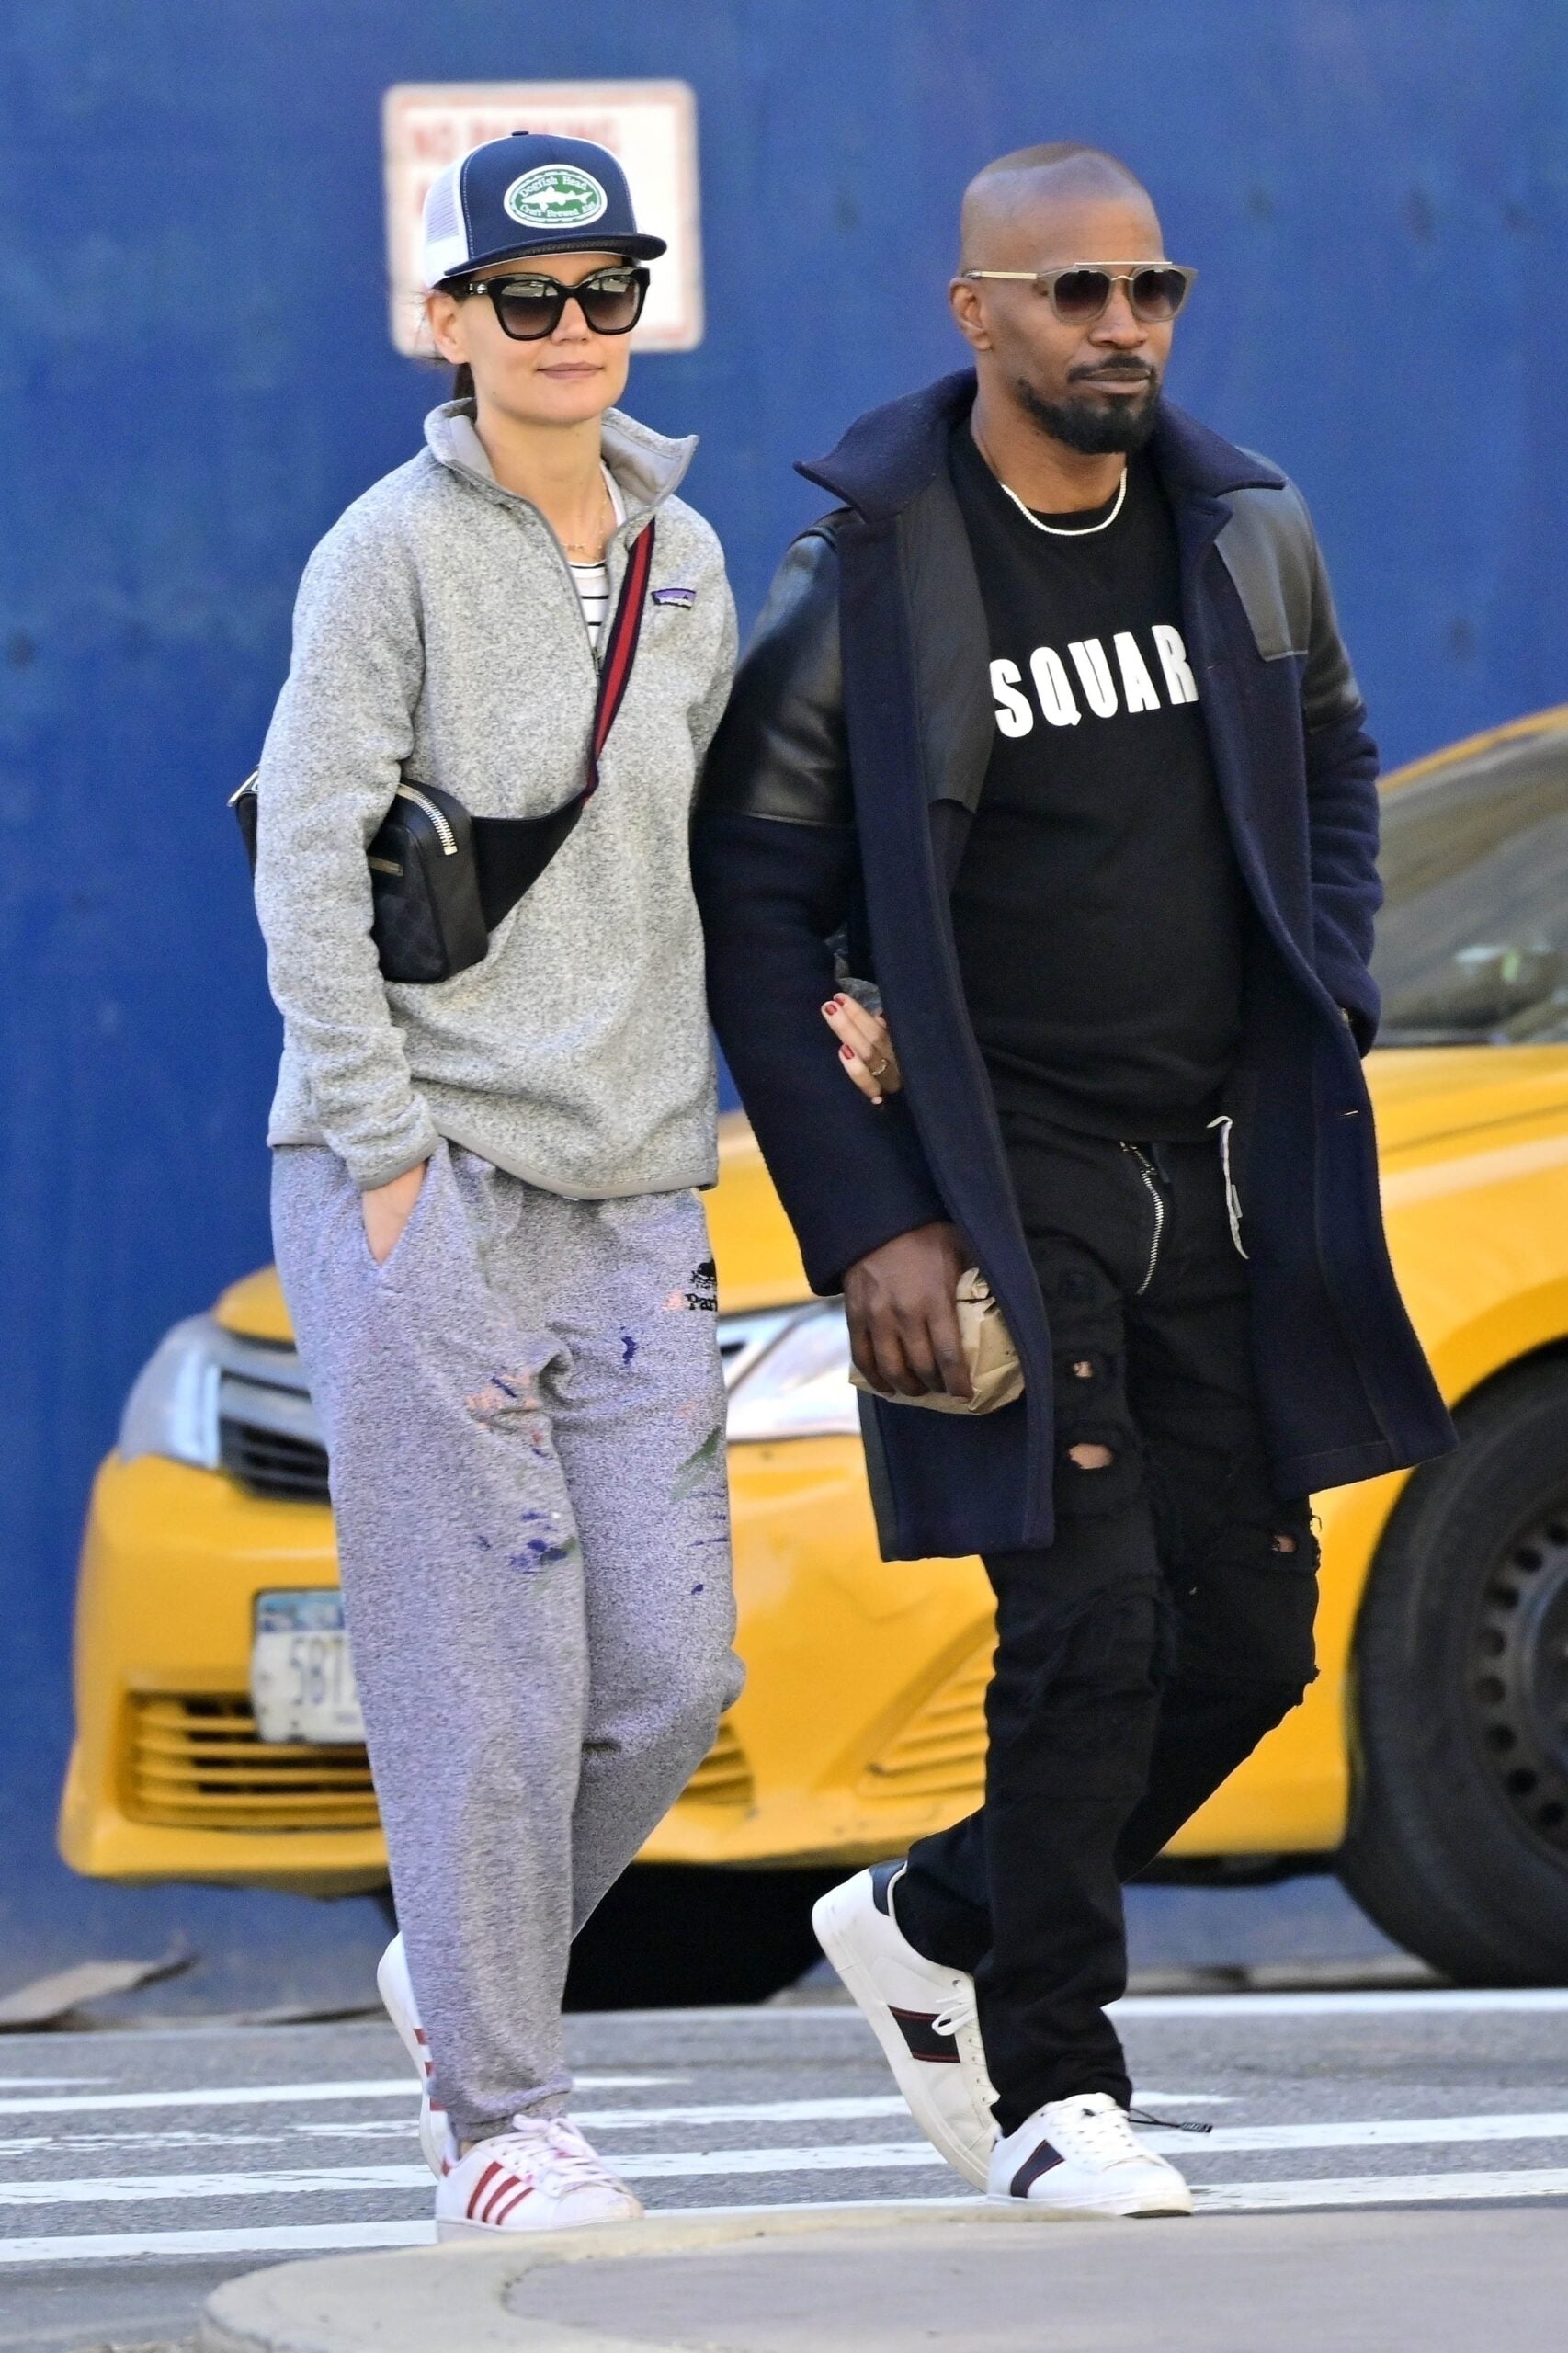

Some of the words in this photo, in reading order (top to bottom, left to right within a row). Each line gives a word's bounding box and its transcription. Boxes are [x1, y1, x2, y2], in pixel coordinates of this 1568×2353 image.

[519, 176, 559, 197] Dogfish
[562, 176, 588, 190] Head
[989, 624, 1199, 738] SQUAR
